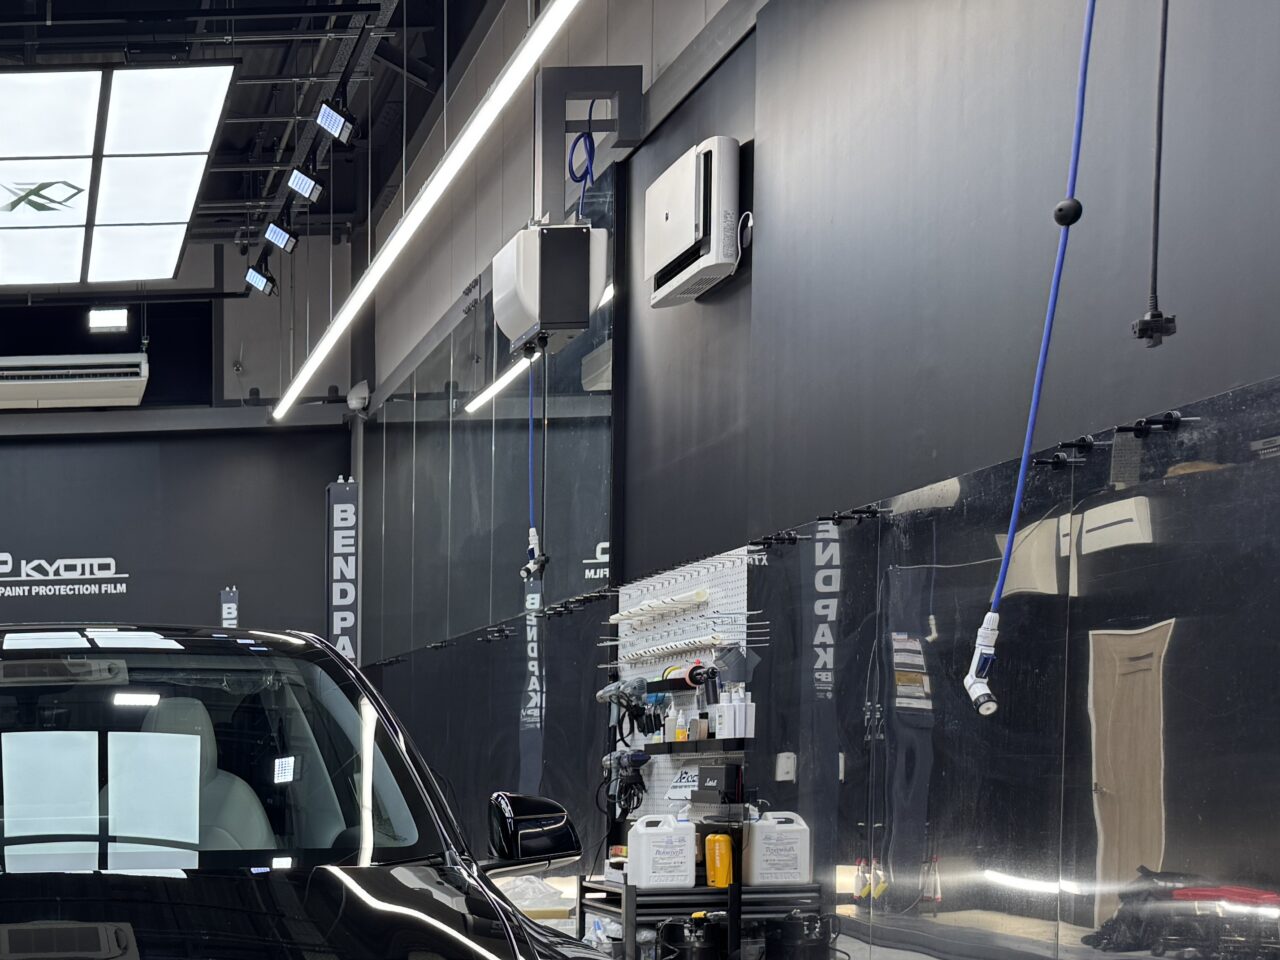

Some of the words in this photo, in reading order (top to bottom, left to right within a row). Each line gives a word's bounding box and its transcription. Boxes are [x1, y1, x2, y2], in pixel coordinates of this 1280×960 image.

[20, 557, 116, 578] KYOTO
[31, 584, 99, 596] PROTECTION
[101, 583, 127, 594] FILM
